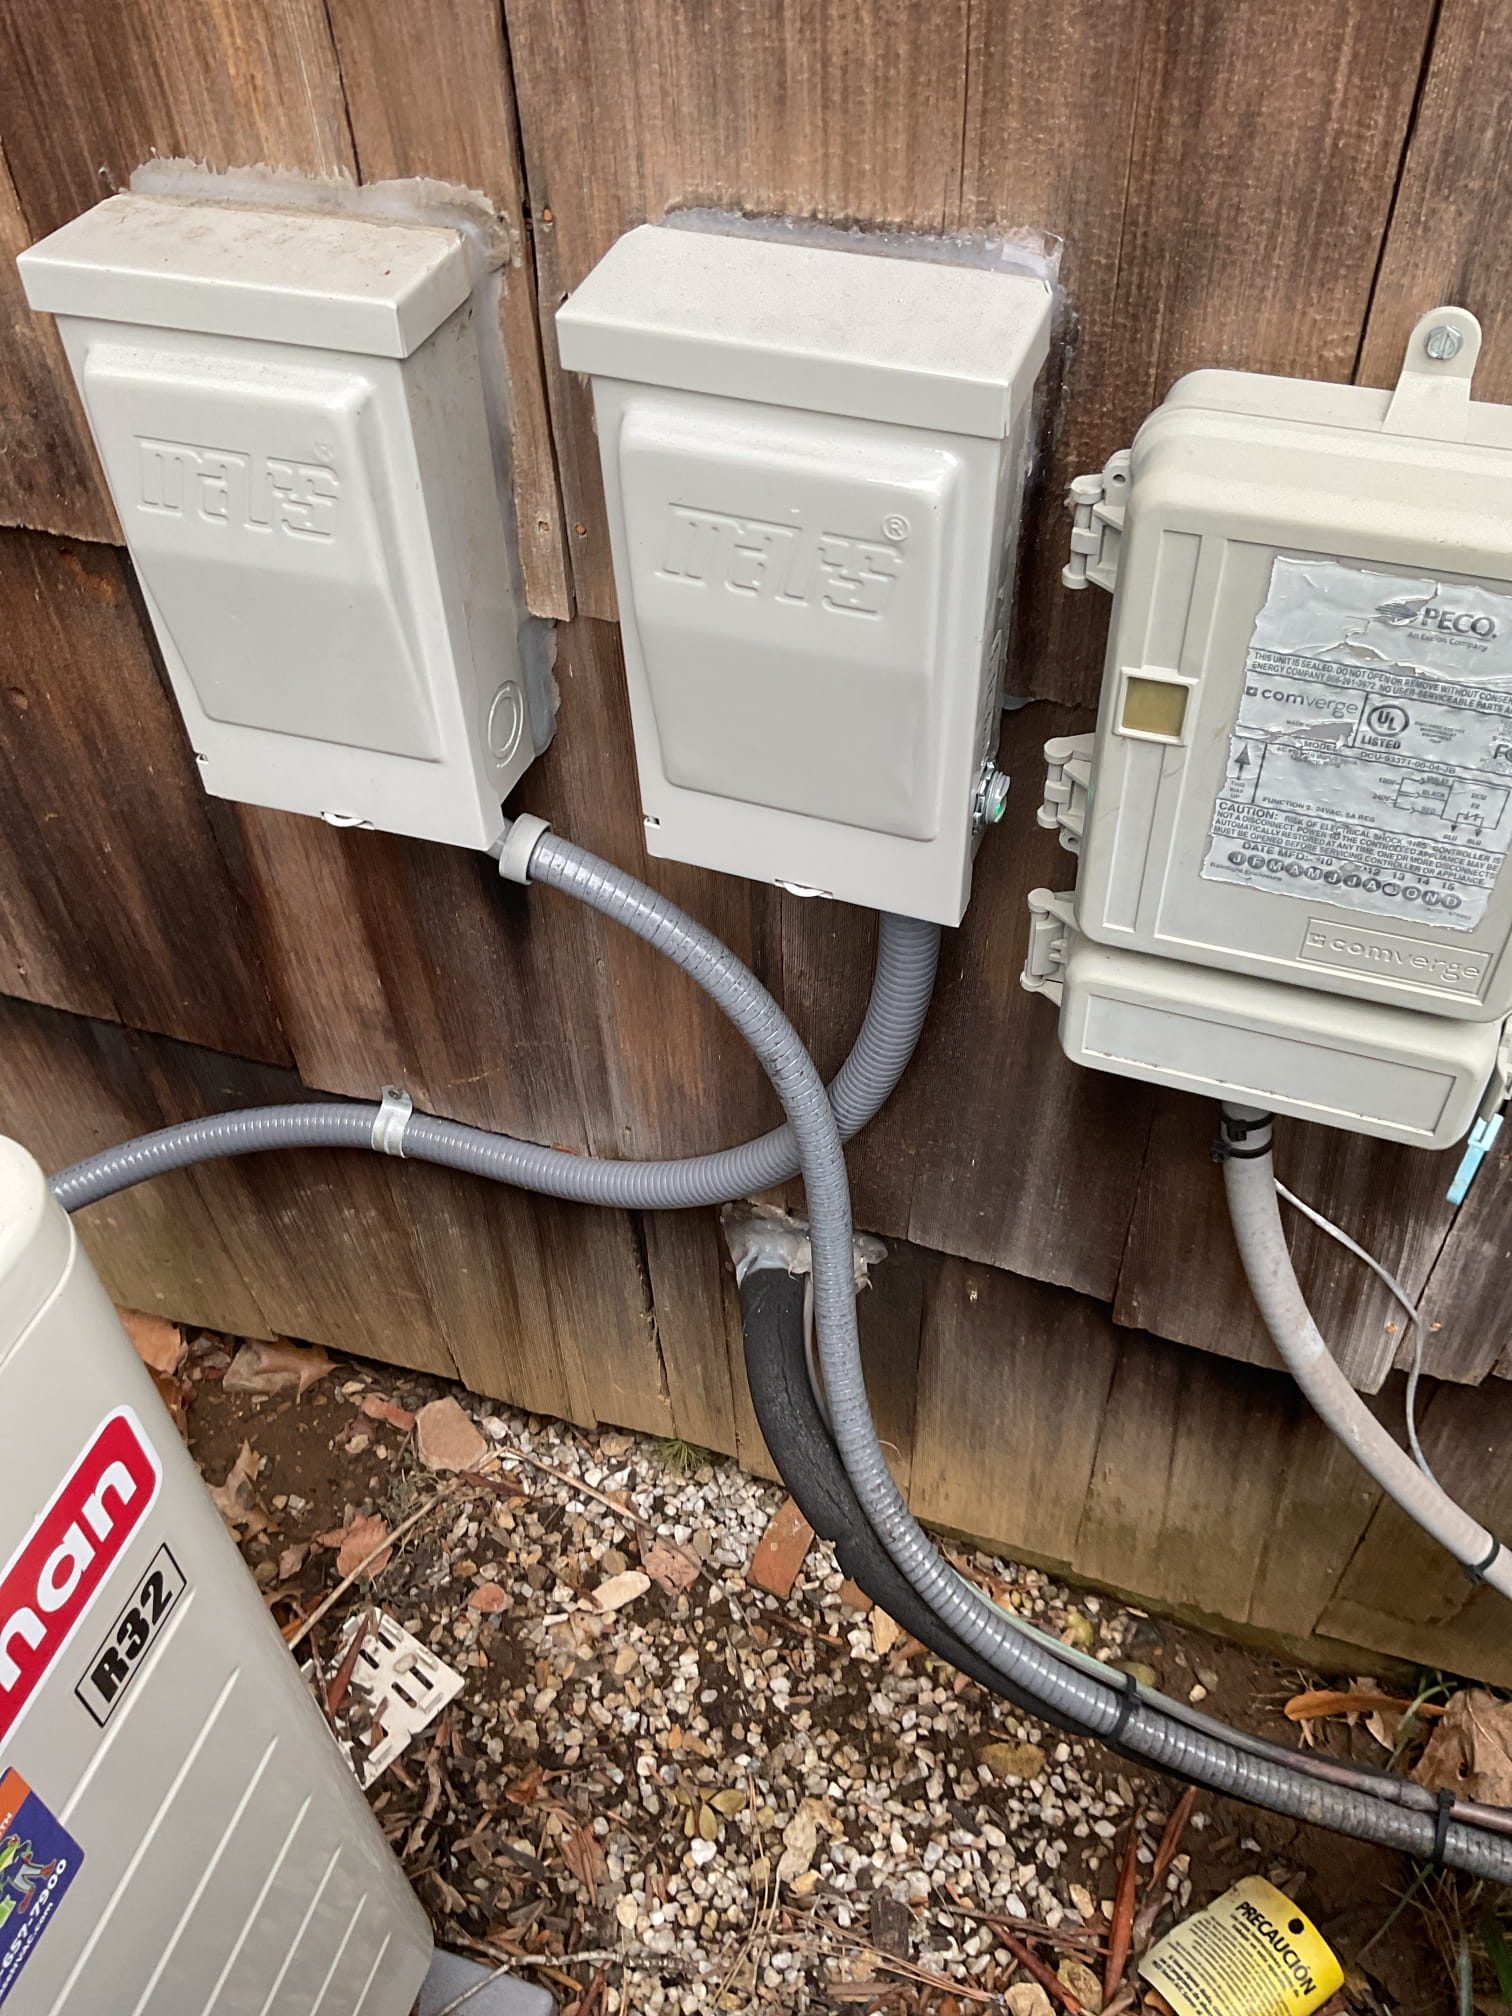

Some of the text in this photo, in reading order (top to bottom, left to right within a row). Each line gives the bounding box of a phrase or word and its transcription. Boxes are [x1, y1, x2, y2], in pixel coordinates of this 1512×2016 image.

[1448, 638, 1488, 652] Company
[1252, 660, 1285, 674] ENERGY
[1285, 666, 1326, 682] COMPANY
[1378, 683, 1391, 694] NO
[1392, 686, 1475, 709] USER-SERVICEABLE
[1475, 701, 1503, 714] PARTS
[1254, 650, 1273, 662] THIS
[1273, 654, 1291, 665] UNIT
[1291, 657, 1300, 667] IS
[1335, 665, 1348, 676] DO
[1348, 668, 1366, 679] NOT
[1366, 671, 1391, 684] OPEN
[1390, 676, 1403, 686] OR
[1403, 678, 1439, 693] REMOVE
[1439, 685, 1479, 700] WITHOUT
[1259, 686, 1359, 720] comverge
[1360, 735, 1401, 751] LISTED
[1262, 796, 1304, 809] FUNCTION
[1421, 789, 1445, 798] BLACK
[1213, 825, 1236, 835] MUST
[1237, 830, 1249, 838] BE
[1250, 832, 1283, 844] OPENED
[1284, 839, 1318, 851] BEFORE
[1318, 846, 1363, 860] SERVICING
[1364, 854, 1421, 872] CONTROLLER
[1422, 866, 1435, 875] OR
[1215, 818, 1280, 836] AUTOMATICALLY
[1281, 831, 1324, 845] RESTORED
[1325, 839, 1335, 847] AT
[1335, 841, 1354, 850] ANY
[1376, 849, 1395, 859] ONE
[1395, 853, 1408, 862] OR
[1409, 856, 1435, 867] MORE
[1435, 861, 1496, 880] DISCONNECTS
[1217, 811, 1233, 819] NOT
[1296, 826, 1326, 838] POWER
[1328, 832, 1340, 841] TO
[1342, 835, 1359, 844] THE
[1359, 838, 1415, 855] CONTROLLED
[1416, 850, 1464, 865] APPLIANCE
[1466, 859, 1485, 869] MAY
[1486, 863, 1498, 871] BE
[1218, 801, 1278, 820] CAUTION:
[1284, 815, 1303, 825] RISK
[1305, 819, 1318, 828] OF
[1319, 822, 1370, 838] ELECTRICAL
[1432, 845, 1490, 862] CONTROLLER
[1242, 841, 1275, 854] DATE
[1391, 872, 1405, 881] 13
[1416, 877, 1430, 886] 14
[1441, 882, 1455, 891] 15
[1329, 938, 1482, 984] comverge
[90, 1570, 173, 1703] R32
[1235, 1901, 1317, 1996] PRECAUCIÓN
